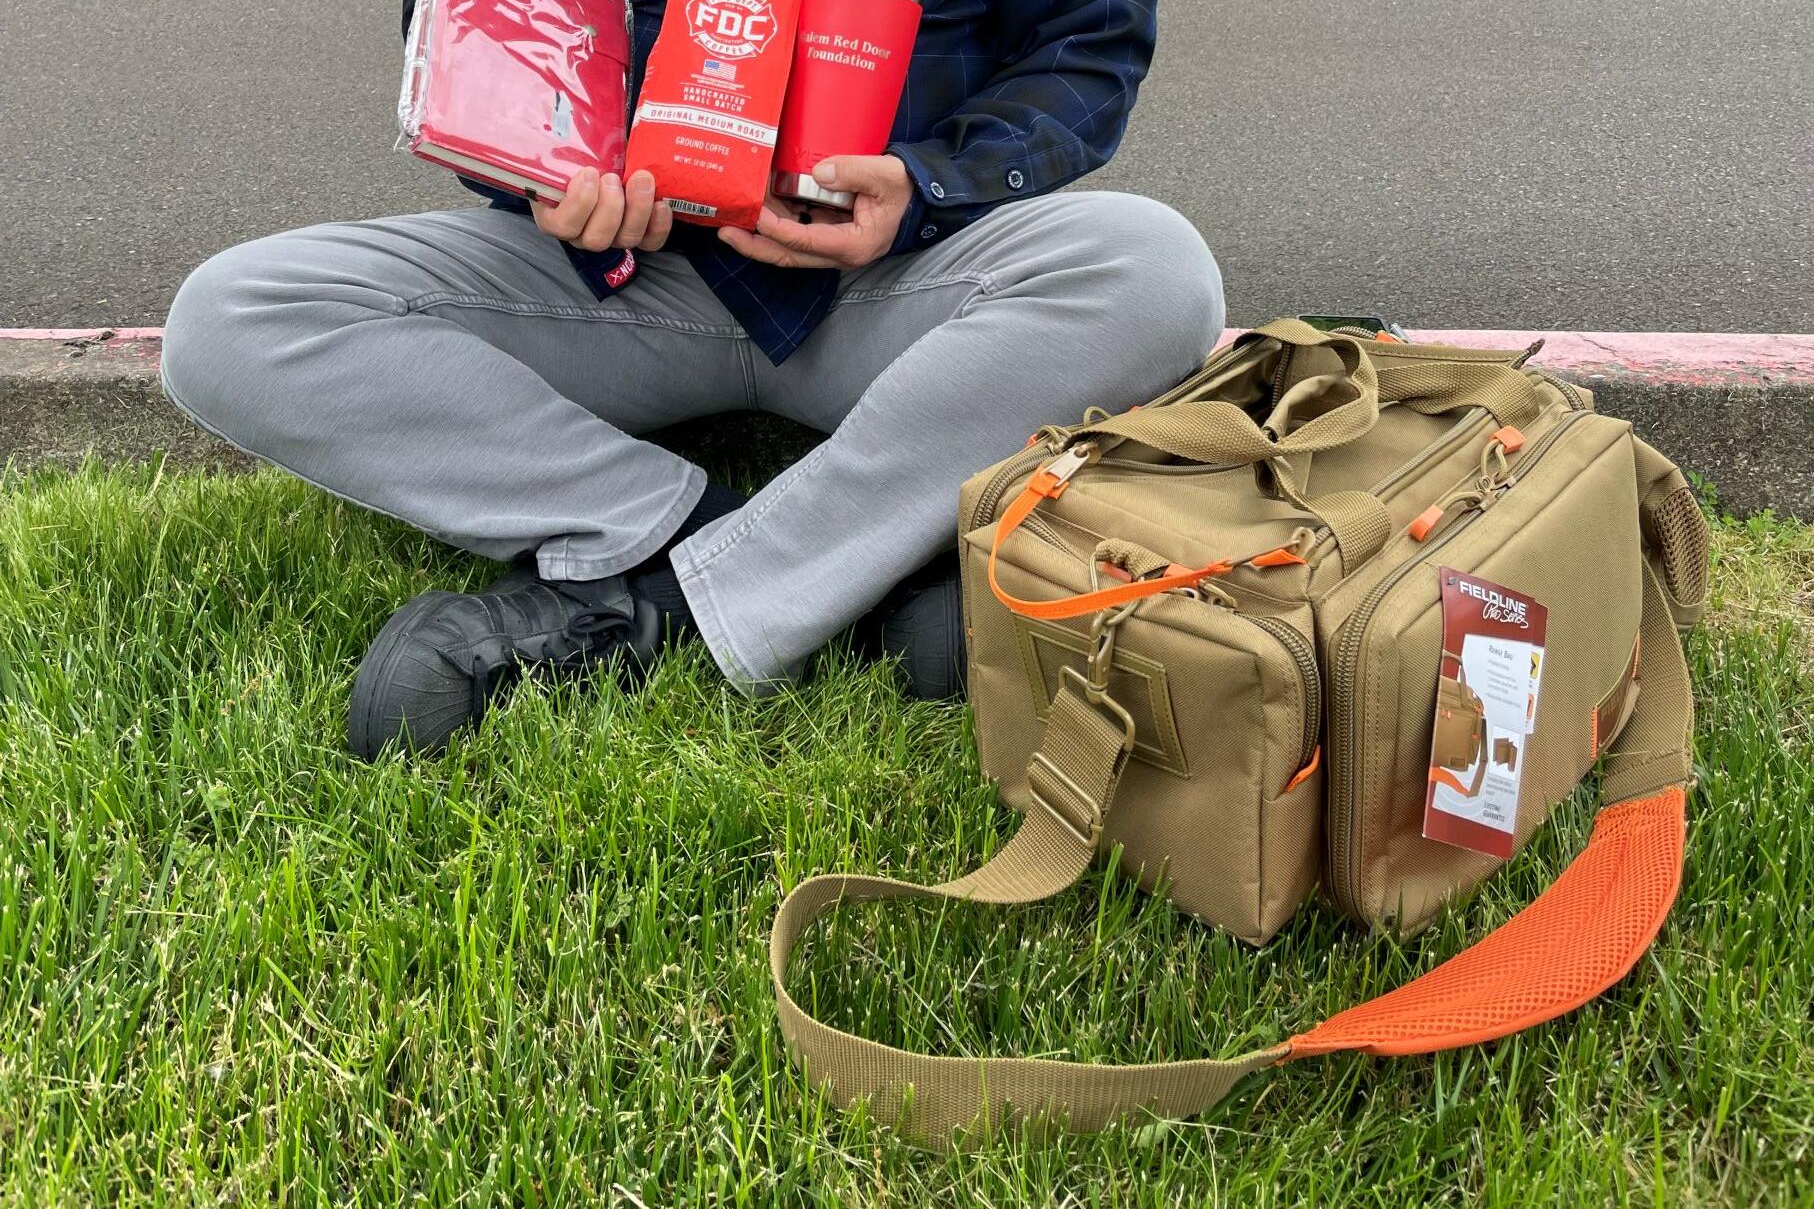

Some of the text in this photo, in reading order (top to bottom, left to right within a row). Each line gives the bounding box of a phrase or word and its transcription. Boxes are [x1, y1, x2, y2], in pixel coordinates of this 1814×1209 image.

[695, 2, 768, 41] FDC
[705, 39, 744, 55] COFFEE
[807, 46, 876, 71] Foundation
[833, 35, 859, 50] Red
[862, 41, 891, 59] Door
[683, 86, 745, 106] HANDCRAFTED
[683, 94, 742, 113] SMALL BATCH
[650, 109, 766, 140] ORIGINAL MEDIUM ROAST
[675, 136, 730, 156] GROUND COFFEE
[1460, 580, 1526, 616] FIELDLINE
